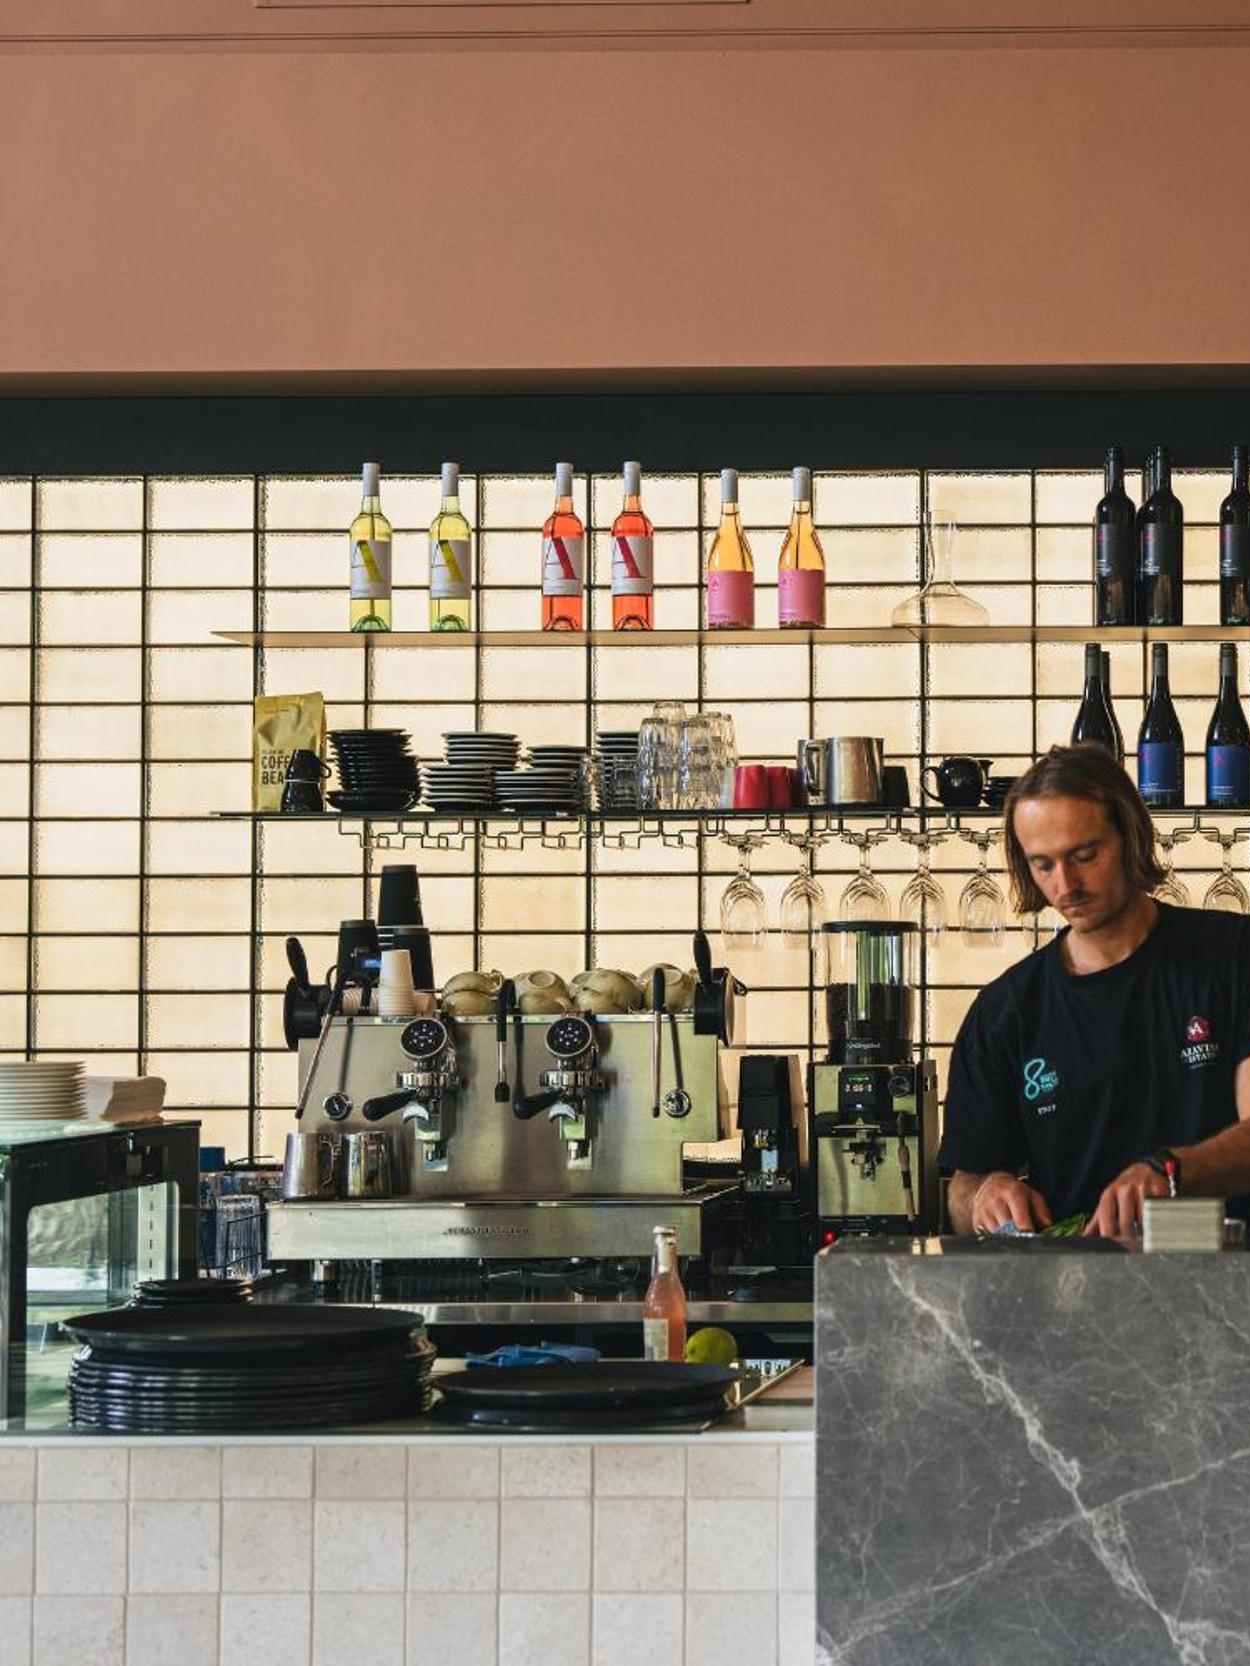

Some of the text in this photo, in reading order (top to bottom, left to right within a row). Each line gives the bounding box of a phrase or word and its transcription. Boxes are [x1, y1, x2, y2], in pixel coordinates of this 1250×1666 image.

[261, 756, 291, 769] COFF
[261, 771, 284, 785] BEA
[1024, 1058, 1046, 1100] 8
